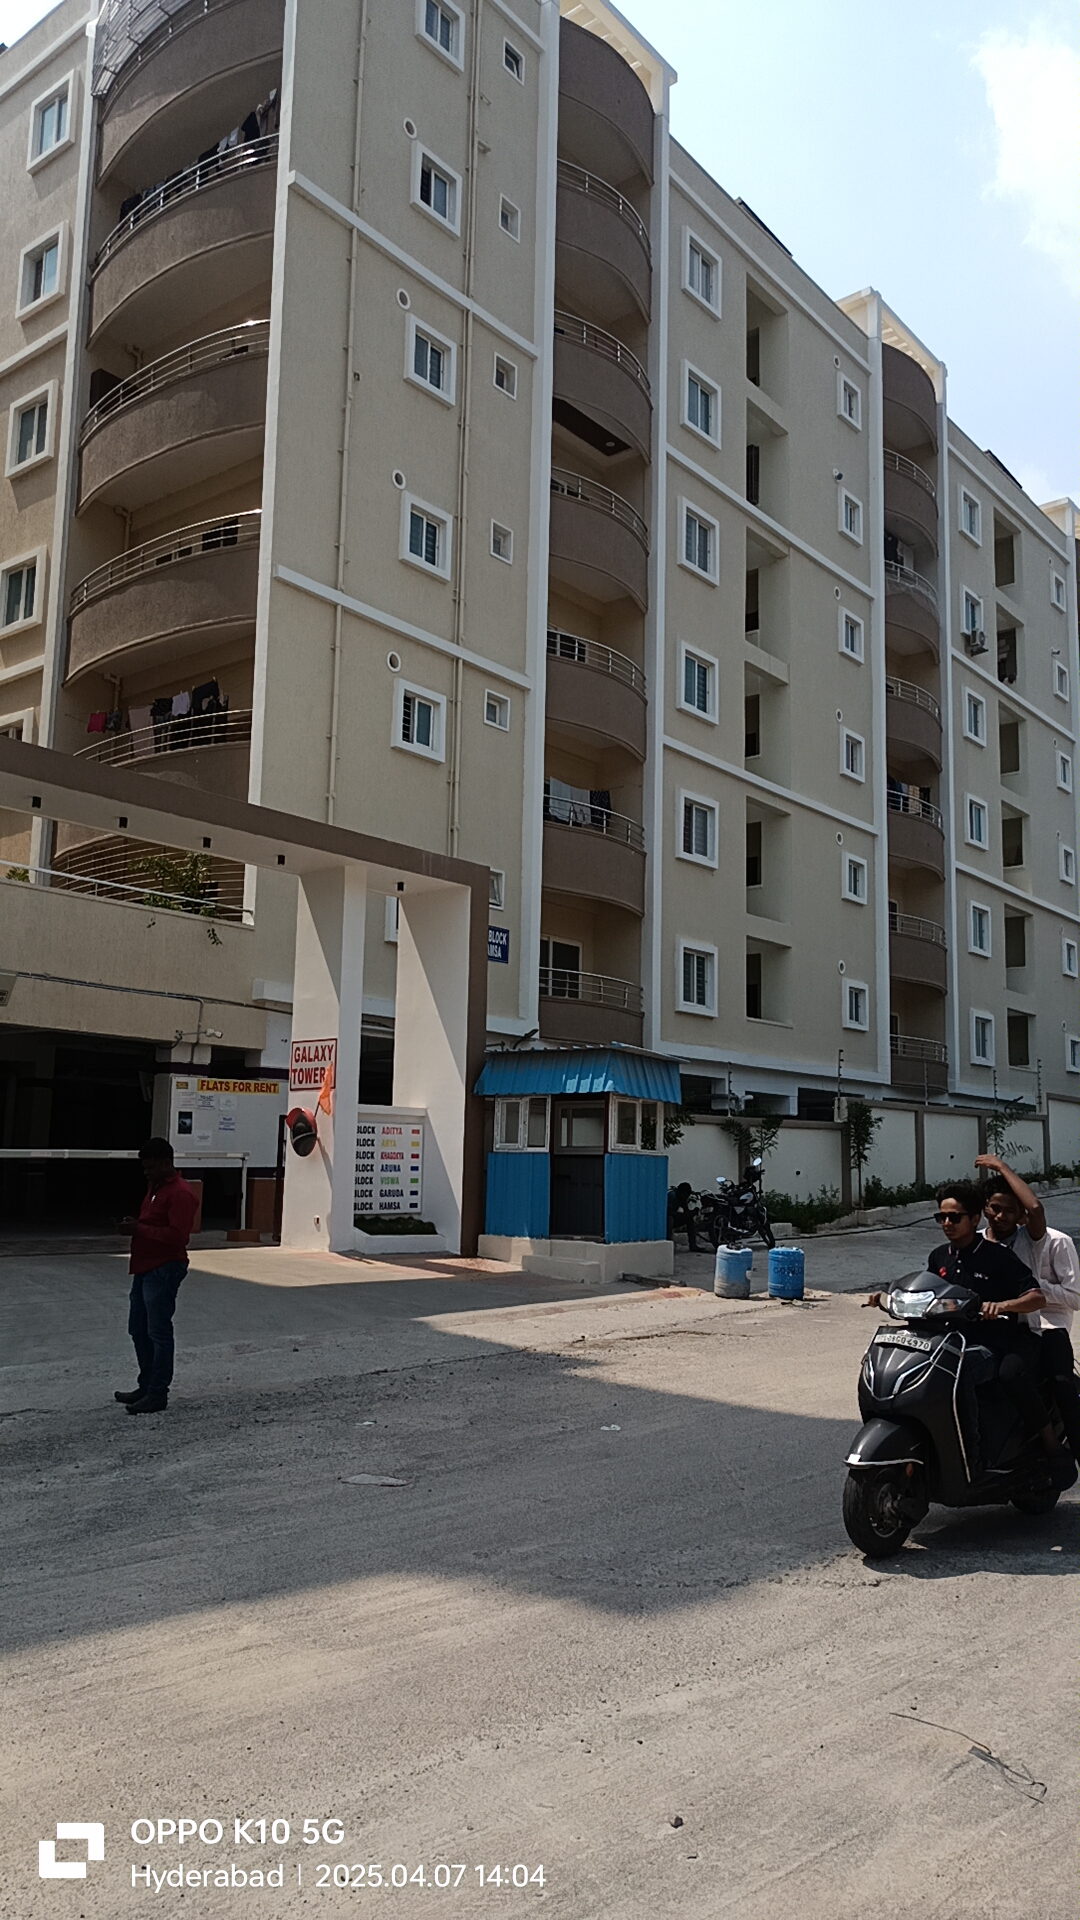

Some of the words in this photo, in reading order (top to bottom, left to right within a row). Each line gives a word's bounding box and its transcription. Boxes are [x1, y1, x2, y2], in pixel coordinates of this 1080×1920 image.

[488, 930, 507, 945] BLOCK
[294, 1044, 334, 1063] GALAXY
[292, 1066, 331, 1085] TOWER
[200, 1080, 230, 1092] FLATS
[232, 1081, 251, 1092] FOR
[253, 1083, 278, 1093] RENT
[381, 1127, 402, 1135] ADITYA
[380, 1164, 401, 1172] ARUNA
[380, 1177, 400, 1185] VISWA
[379, 1189, 404, 1198] GARUDA
[379, 1202, 401, 1210] HAMSA
